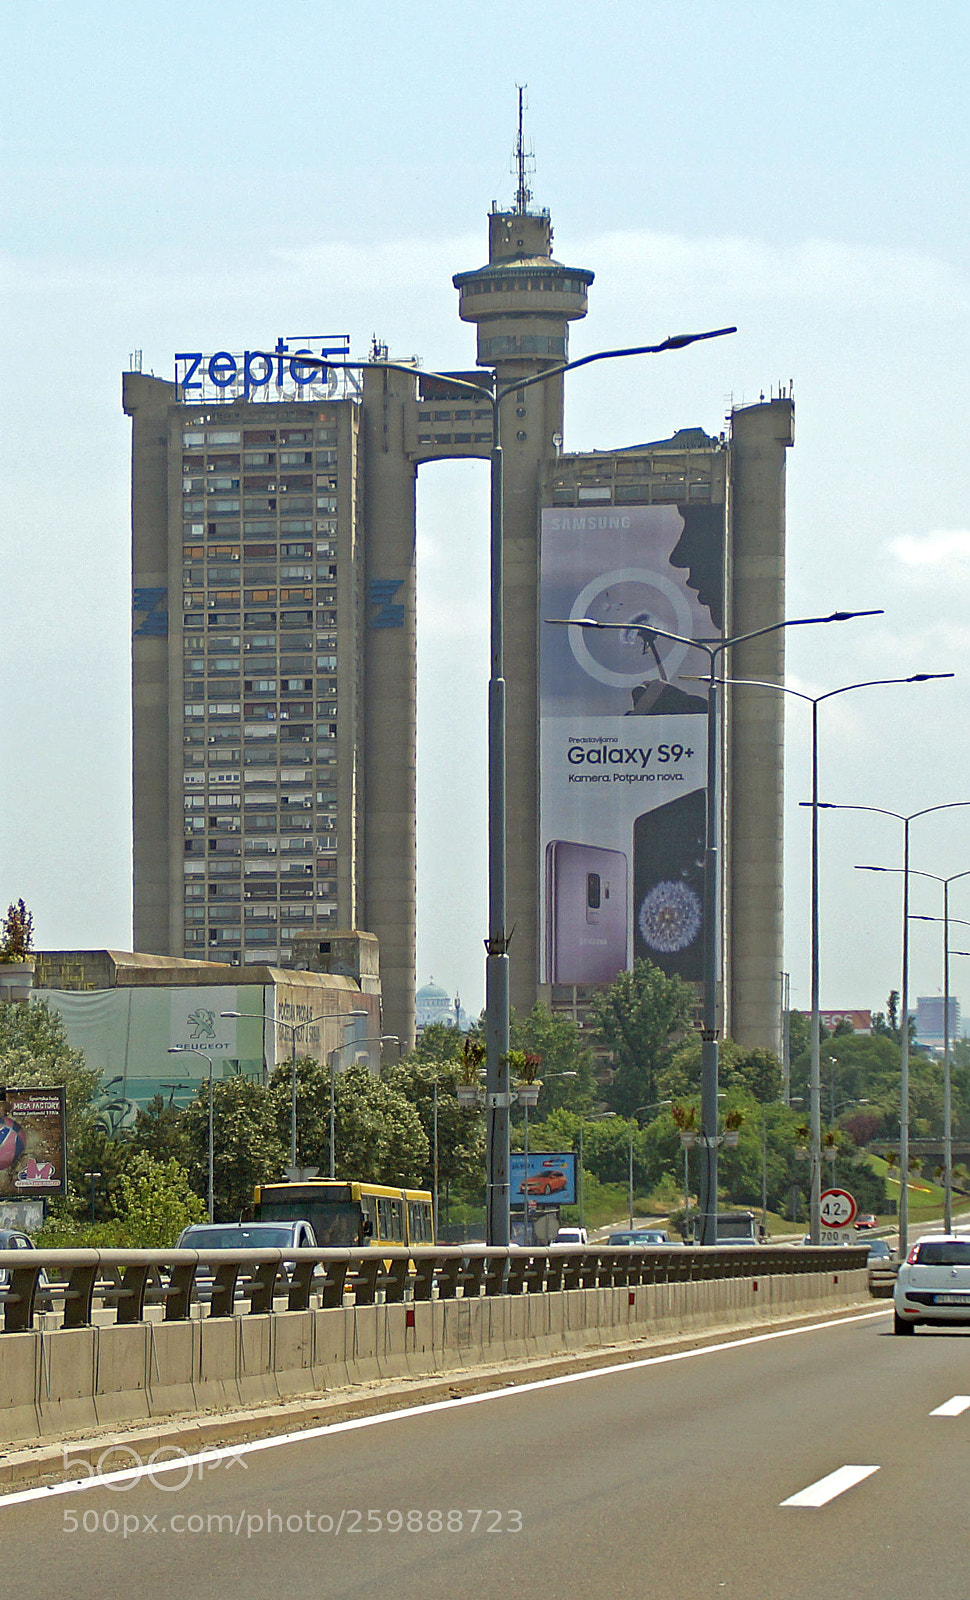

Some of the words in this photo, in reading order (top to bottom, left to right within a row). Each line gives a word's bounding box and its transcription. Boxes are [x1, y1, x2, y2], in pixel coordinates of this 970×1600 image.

[174, 337, 350, 400] zepter
[551, 516, 631, 531] SAMSUNG
[567, 745, 653, 769] Galaxy
[657, 743, 694, 763] S9+
[568, 774, 611, 783] Kamera.
[613, 773, 655, 784] Potpuno
[657, 774, 685, 782] nova.
[13, 1102, 31, 1110] MEGA
[32, 1101, 60, 1110] FACTORY
[821, 1231, 839, 1242] 700
[842, 1233, 850, 1241] m
